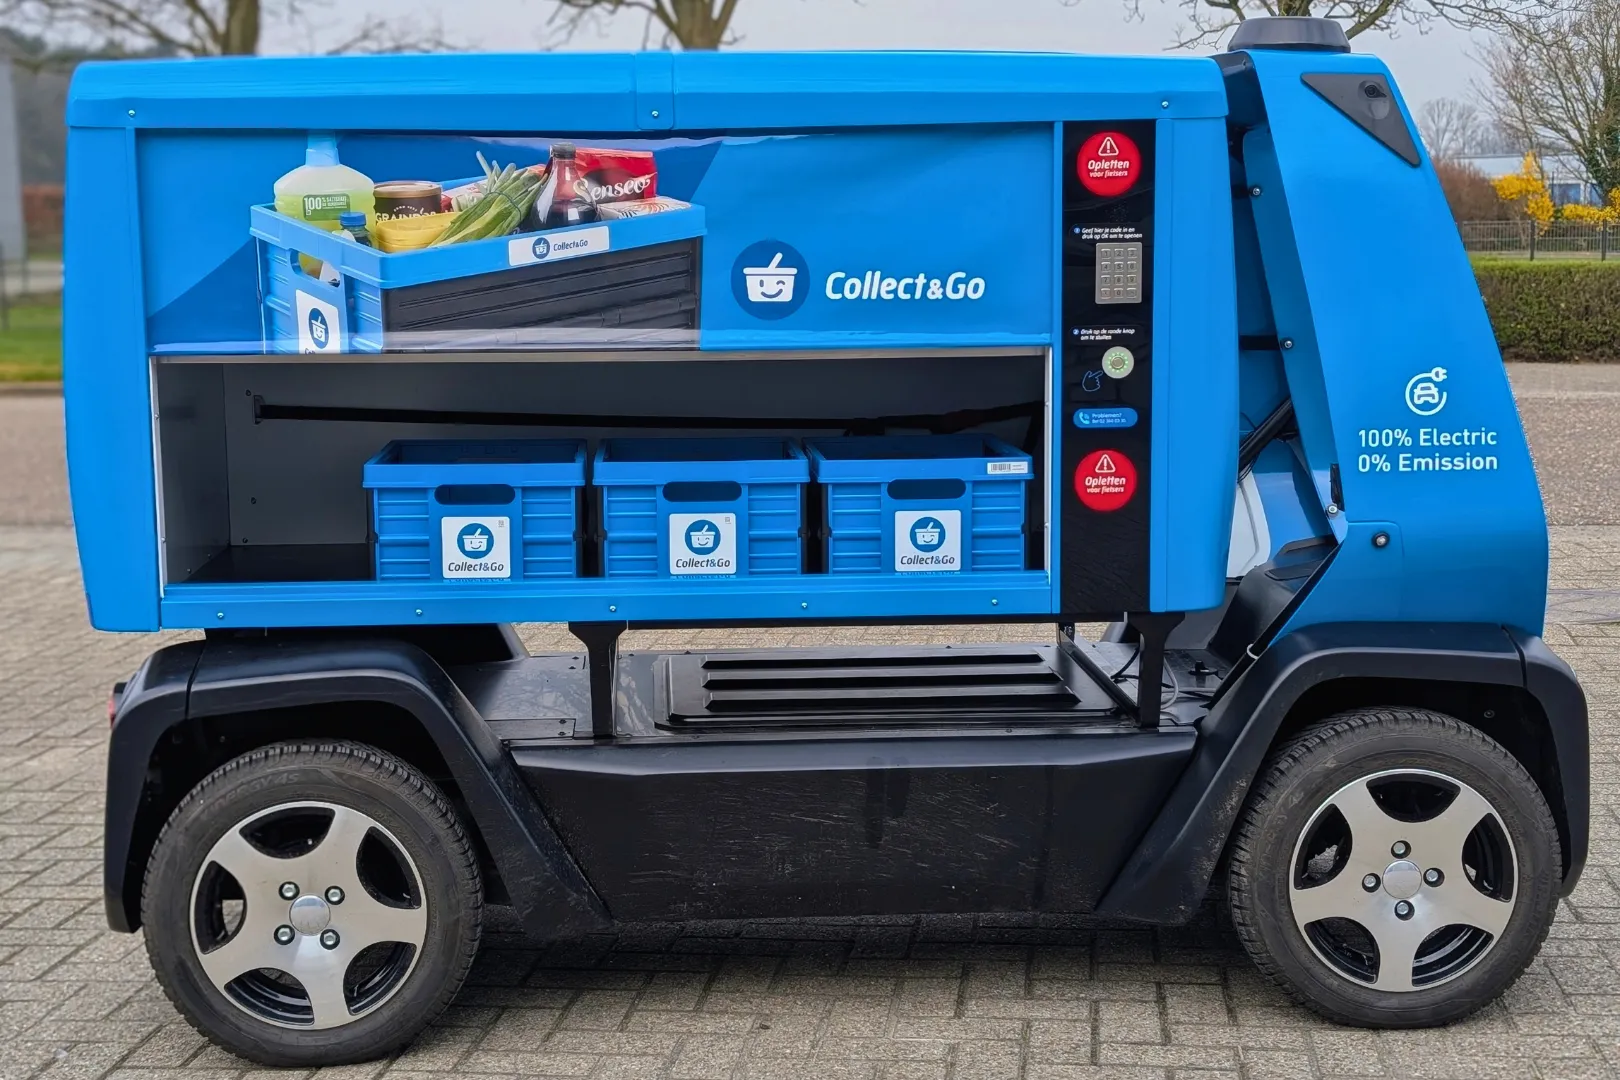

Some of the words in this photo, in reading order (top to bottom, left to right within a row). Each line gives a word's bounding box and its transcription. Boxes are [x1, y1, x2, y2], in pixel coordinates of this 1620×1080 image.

[1088, 159, 1130, 171] Opletten
[1104, 170, 1128, 178] fietsers
[573, 177, 651, 202] Senseo
[553, 239, 588, 252] Collect&Go
[825, 270, 986, 300] Collect&Go
[1358, 428, 1412, 447] 100%
[1419, 427, 1497, 446] Electric
[1358, 453, 1391, 472] 0%
[1398, 452, 1498, 471] Emission
[1085, 476, 1126, 488] Opletten
[1101, 486, 1124, 494] fietsers
[675, 558, 731, 568] Collect&Go
[900, 554, 955, 565] Collect&Go
[448, 561, 504, 572] Collect&Go
